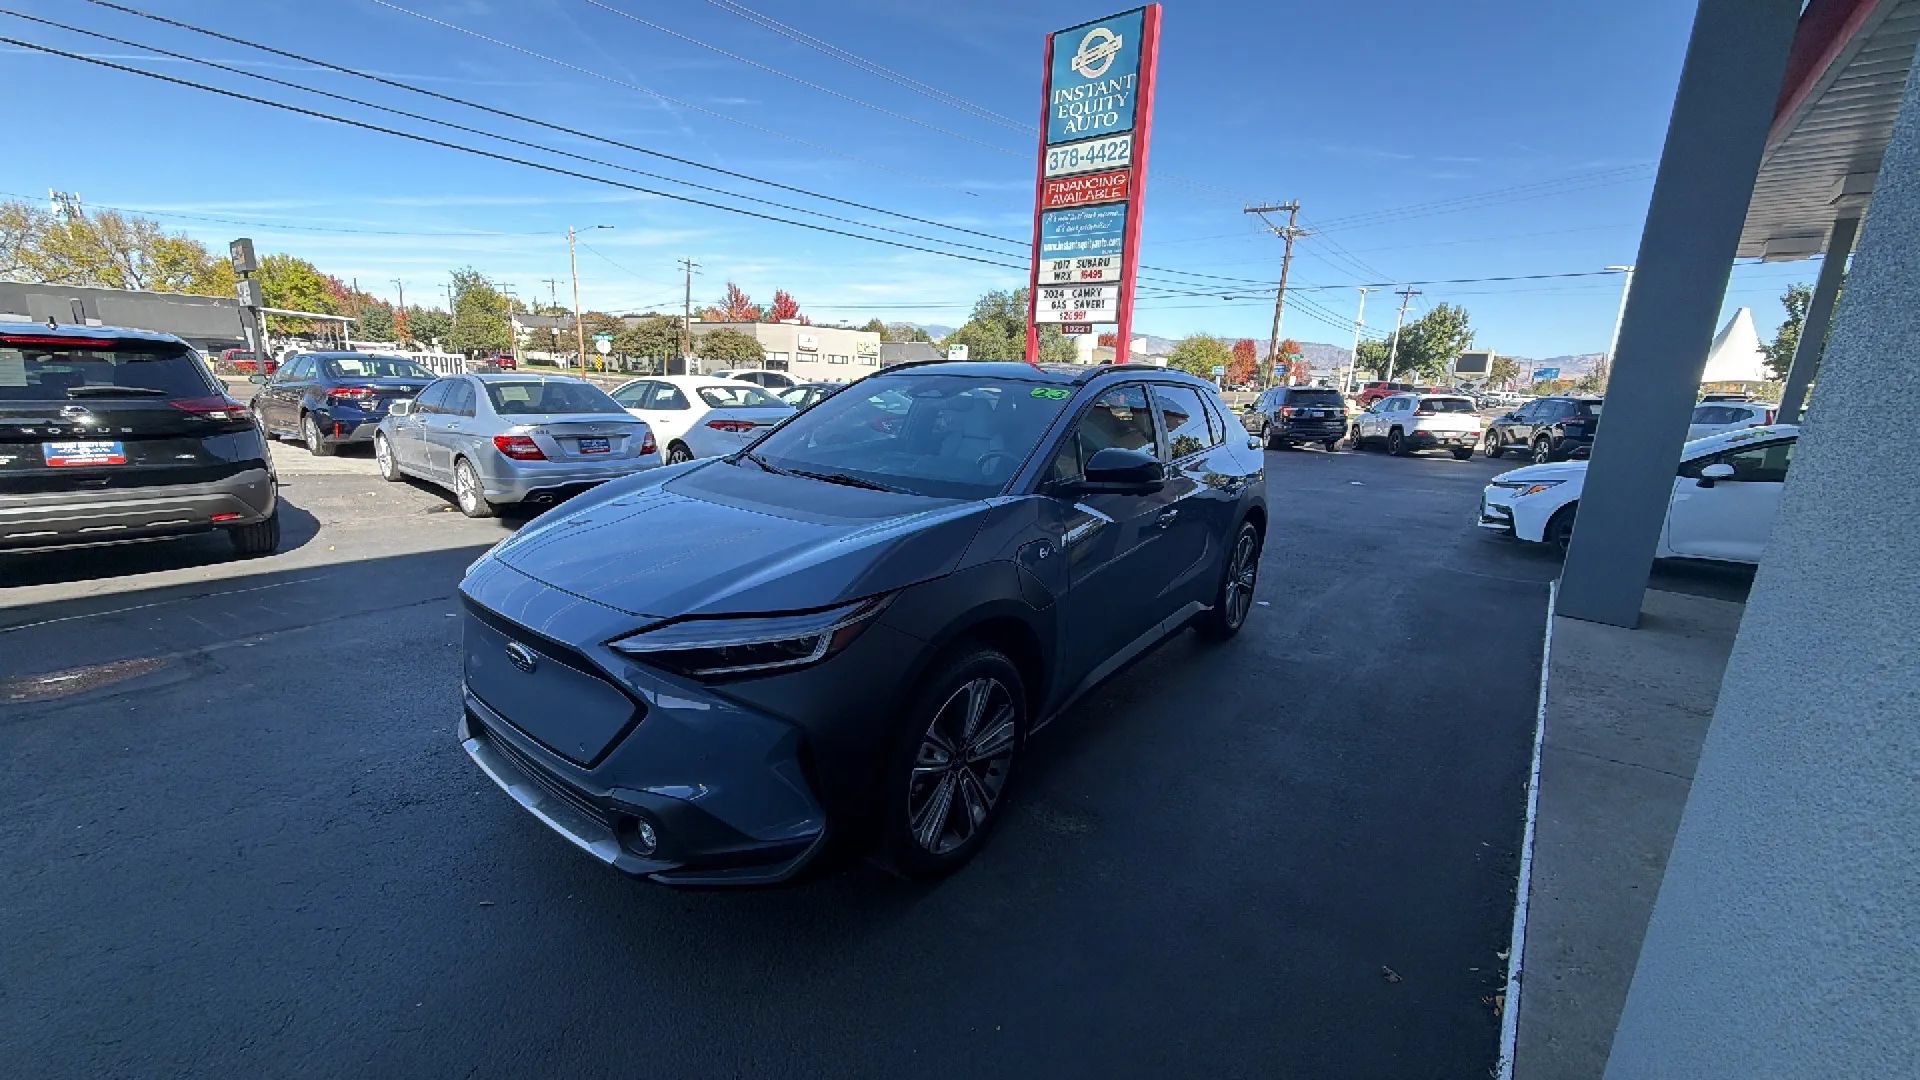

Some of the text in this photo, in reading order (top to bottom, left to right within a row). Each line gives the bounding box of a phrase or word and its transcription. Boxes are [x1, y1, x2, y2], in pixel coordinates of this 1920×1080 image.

[1054, 74, 1137, 105] INSTANT
[1058, 92, 1129, 119] EQUITY
[1063, 111, 1118, 134] AUTO
[1049, 139, 1129, 171] 378-4422
[1048, 174, 1126, 195] FINANCING
[1051, 187, 1121, 205] AVAILABLE
[1053, 257, 1110, 270] 2017 SUBARU
[1053, 270, 1072, 281] WRX
[1043, 287, 1102, 299] 2024 CAMRY
[1051, 299, 1105, 310] GAS SAVER!
